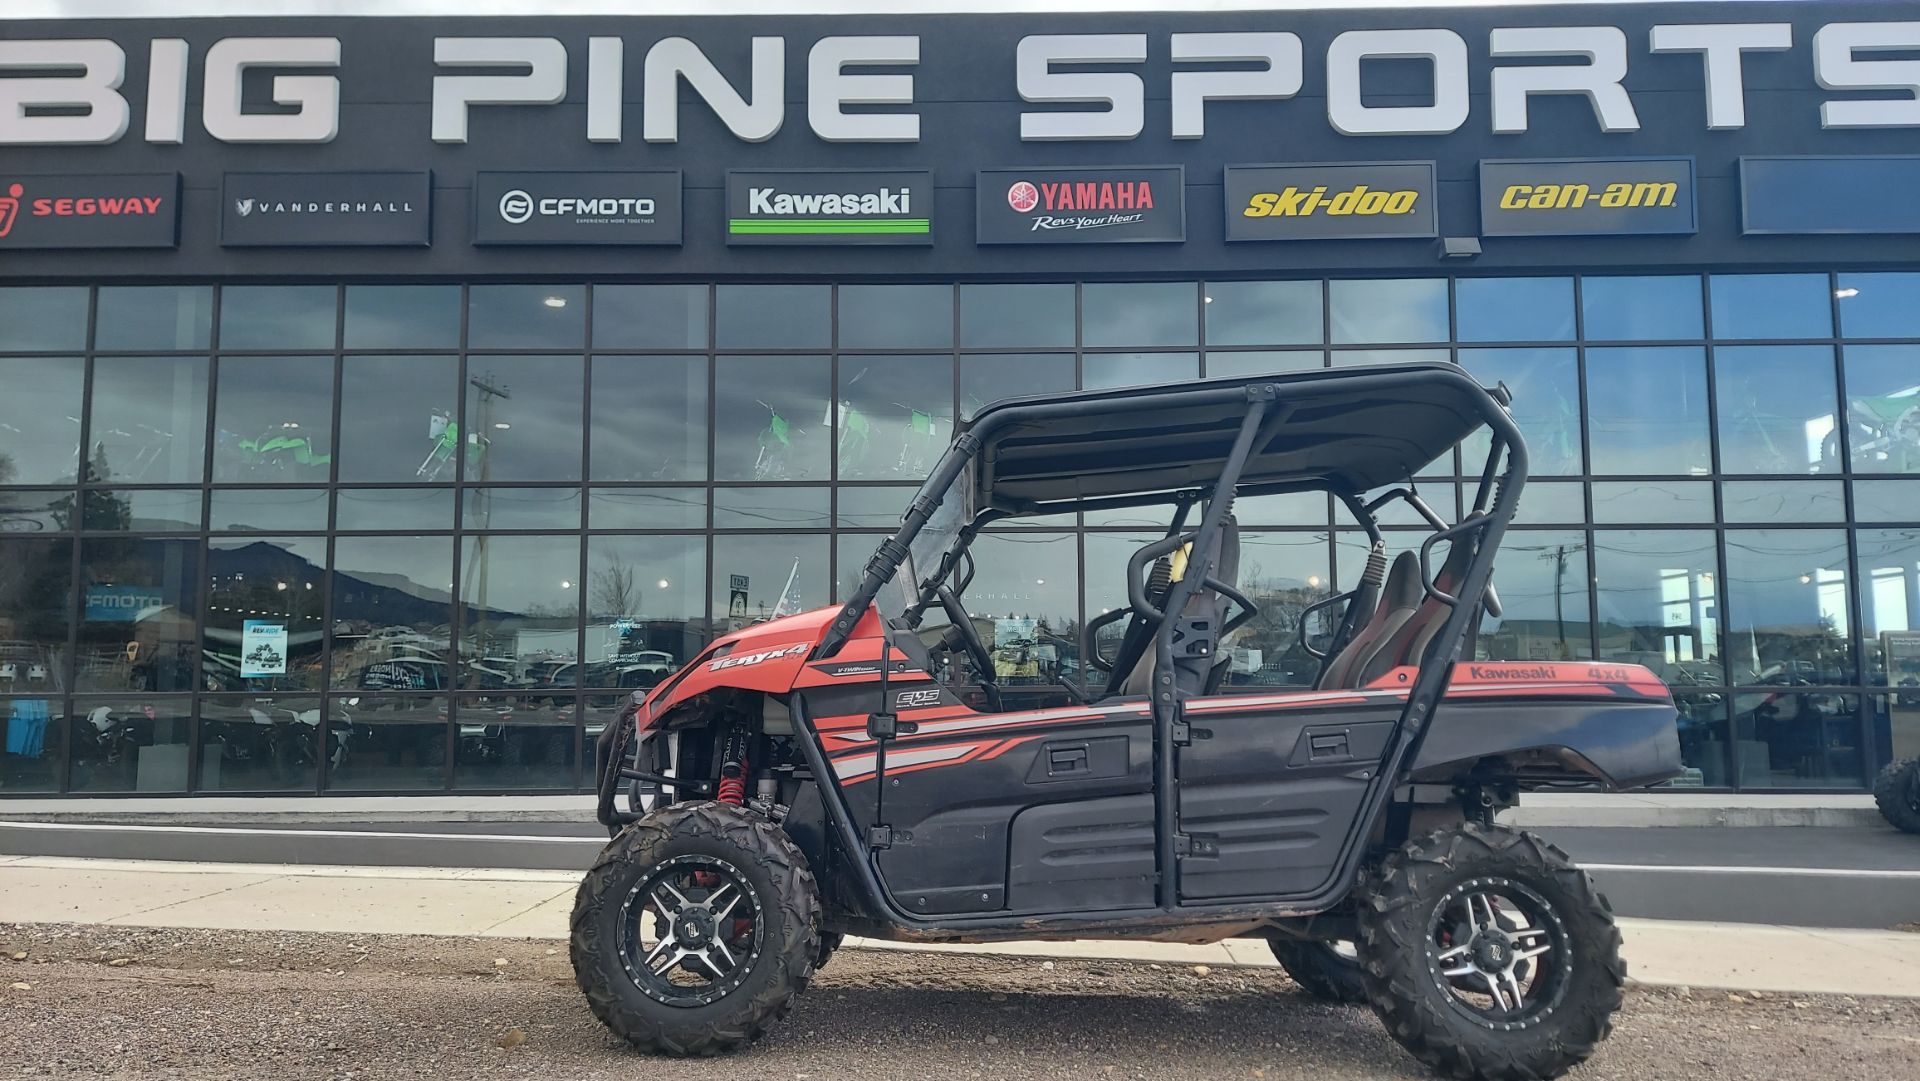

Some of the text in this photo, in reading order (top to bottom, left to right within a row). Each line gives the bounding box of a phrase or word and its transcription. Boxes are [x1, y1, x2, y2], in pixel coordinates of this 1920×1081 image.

[0, 22, 1920, 144] BIG PINE SPORTS
[32, 197, 162, 216] SEGWAY
[539, 198, 655, 215] CFMOTO
[749, 188, 910, 215] Kawasaki
[1041, 181, 1153, 210] YAMAHA
[1243, 185, 1419, 217] ski-doo
[1499, 182, 1678, 209] can-am
[259, 202, 413, 213] VANDERHALL
[1031, 213, 1145, 231] Revs Your Heart
[1470, 666, 1630, 681] Kawasaki 4x4
